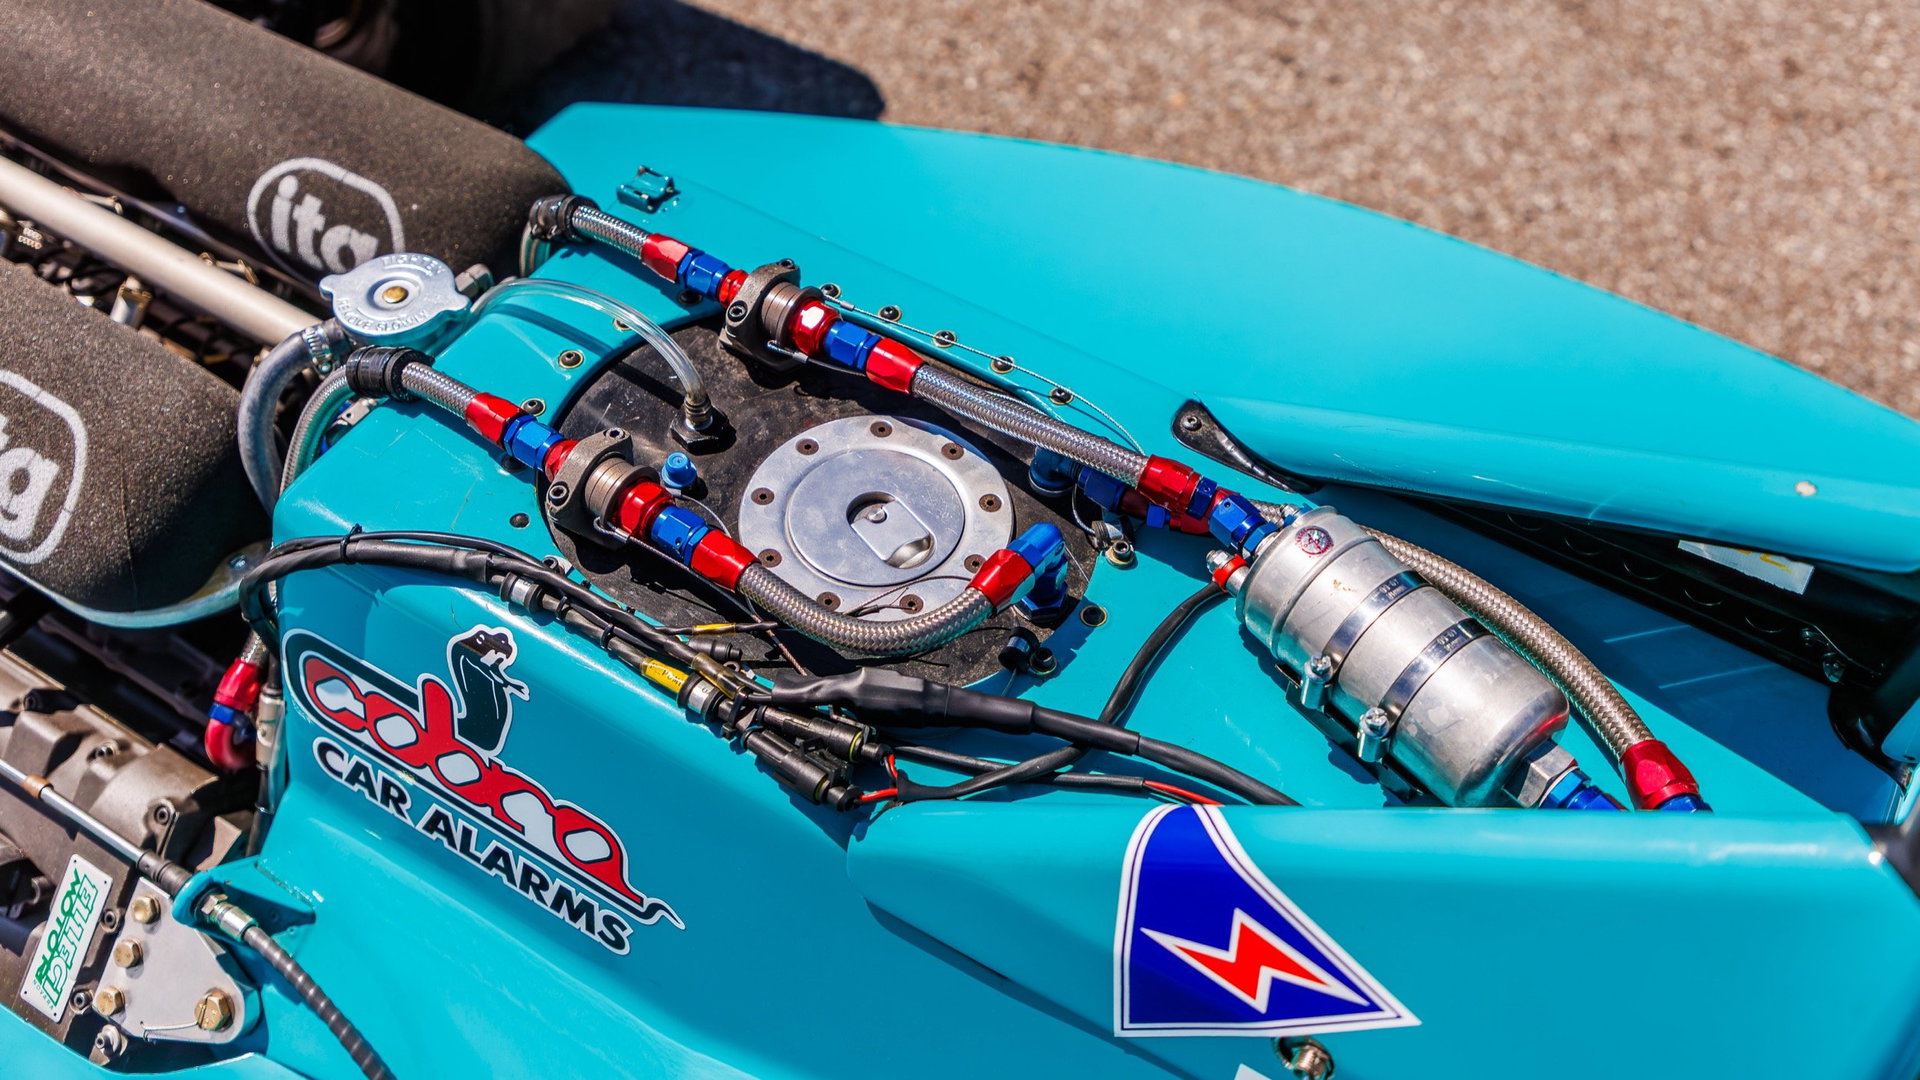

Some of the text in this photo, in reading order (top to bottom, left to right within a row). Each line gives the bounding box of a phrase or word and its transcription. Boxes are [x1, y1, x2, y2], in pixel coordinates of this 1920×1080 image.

[315, 739, 630, 953] CAR ALARMS
[35, 868, 81, 986] MOTOR
[42, 874, 99, 1006] ELLEGI
[33, 978, 55, 1011] NOVARA
